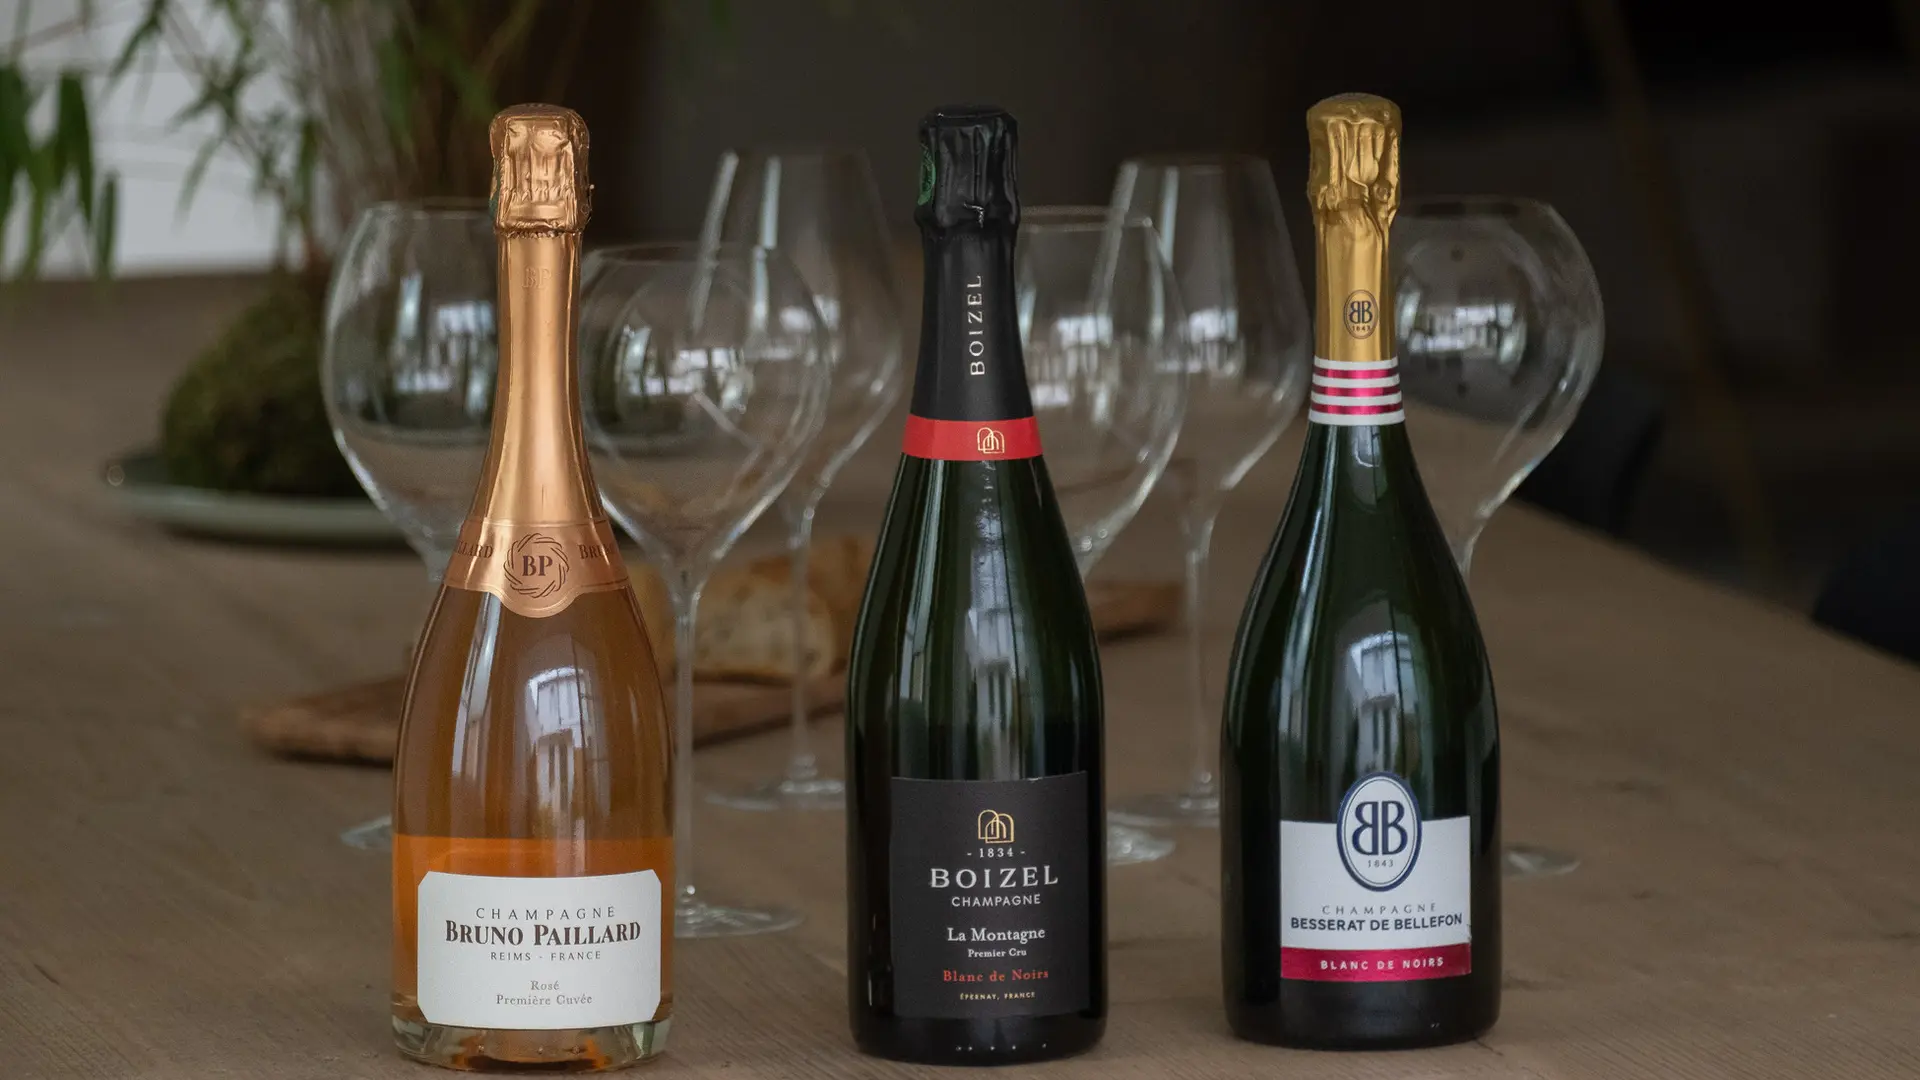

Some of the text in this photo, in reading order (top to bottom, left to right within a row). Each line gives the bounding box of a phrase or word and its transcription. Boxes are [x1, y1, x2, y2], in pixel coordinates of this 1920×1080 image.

[967, 275, 985, 376] BOIZEL
[522, 555, 553, 577] BP
[979, 847, 1014, 858] 1834
[1367, 860, 1394, 868] 1843
[929, 865, 1059, 889] BOIZEL
[951, 894, 1041, 907] CHAMPAGNE
[475, 906, 616, 920] CHAMPAGNE
[1322, 902, 1437, 916] CHAMPAGNE
[1290, 913, 1462, 932] BESSERAT DE BELLEFON
[445, 919, 641, 946] BRUNO PAILLARD
[947, 927, 1046, 944] La Montagne
[490, 952, 532, 961] REIMS
[550, 950, 601, 961] FRANCE
[967, 947, 1027, 958] Premier Cru
[1319, 956, 1444, 971] BLANC DE NOIRS
[943, 968, 1049, 982] Blanc de Noirs
[530, 980, 560, 991] Rosé
[496, 993, 593, 1005] Première Cuvée
[1004, 991, 1036, 1000] FRANCE
